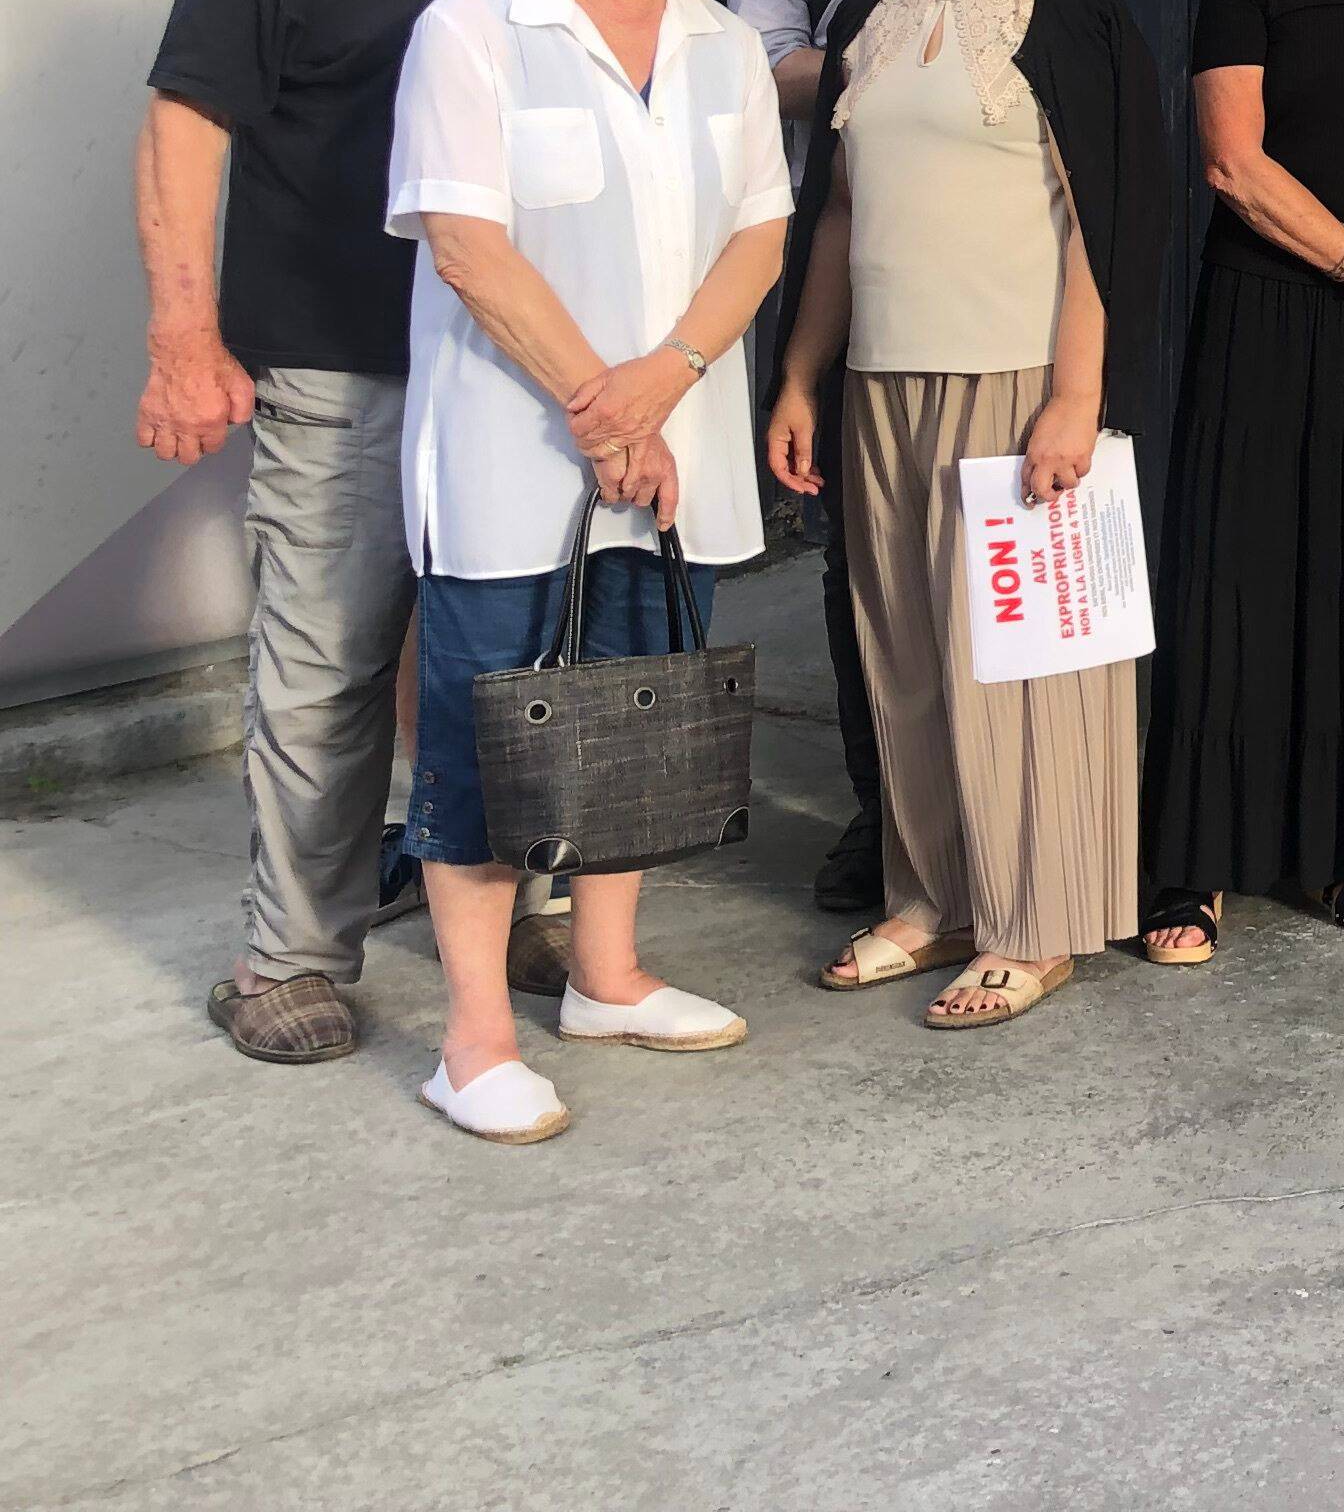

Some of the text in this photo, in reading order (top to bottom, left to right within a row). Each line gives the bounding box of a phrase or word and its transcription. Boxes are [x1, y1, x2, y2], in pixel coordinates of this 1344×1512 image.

[1066, 489, 1078, 518] TRA
[1031, 548, 1047, 584] AUX
[1048, 498, 1075, 639] EXPROPRIATION
[1071, 532, 1084, 572] LIGNE
[984, 517, 1024, 624] NON !
[1075, 574, 1087, 592] LA
[1080, 608, 1091, 636] NON
